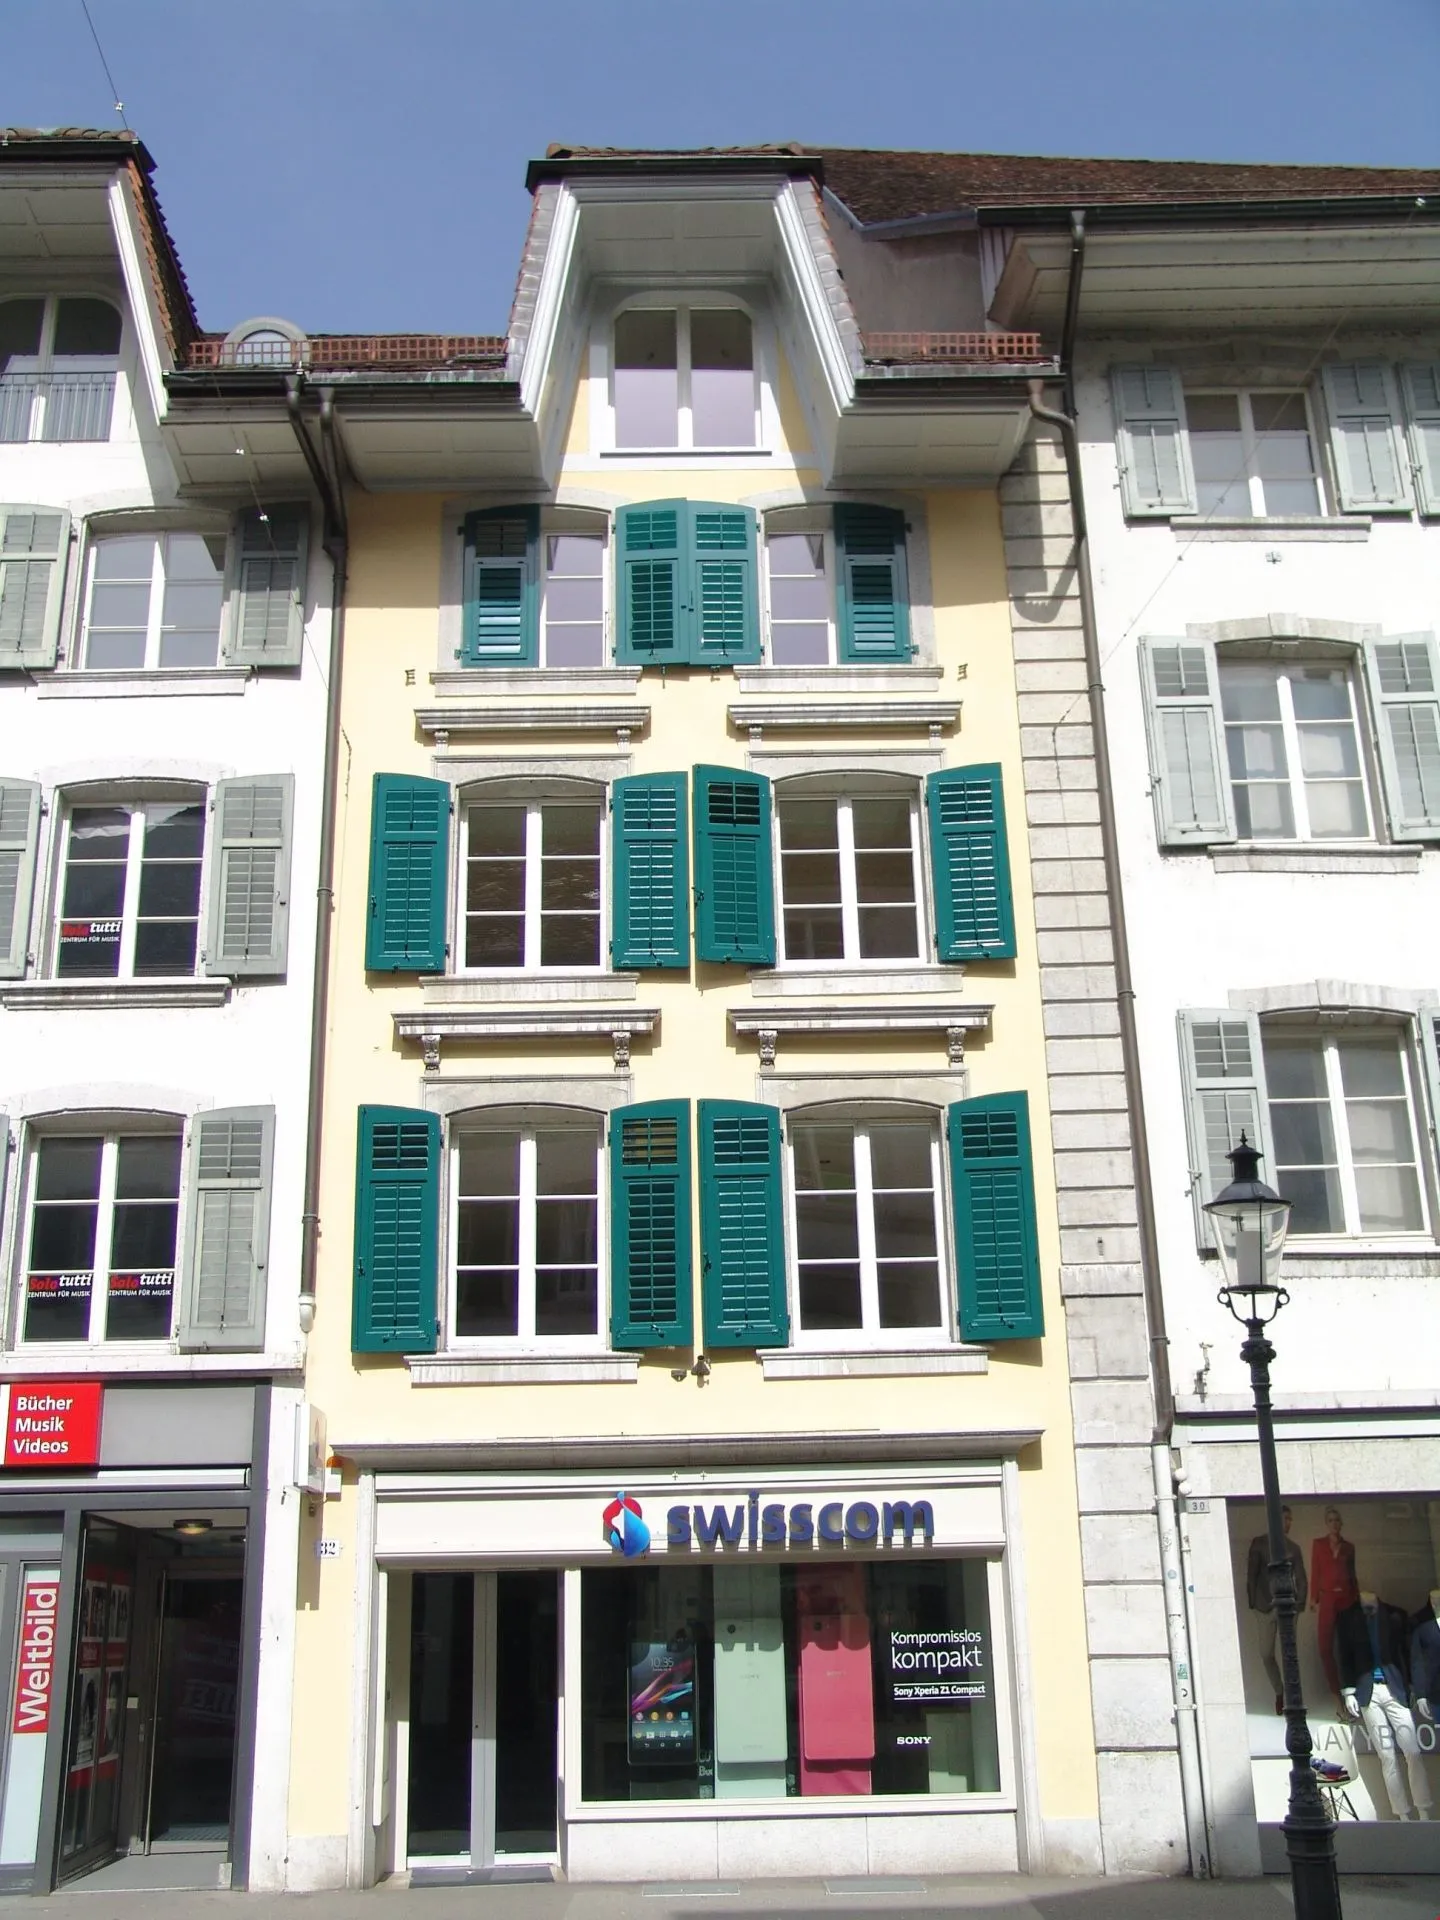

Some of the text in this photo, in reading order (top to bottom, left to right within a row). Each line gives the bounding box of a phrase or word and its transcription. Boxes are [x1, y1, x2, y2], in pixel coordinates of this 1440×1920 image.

[90, 921, 121, 932] tutti
[59, 1273, 92, 1287] tutti
[139, 1272, 173, 1286] tutti
[17, 1396, 73, 1411] Bücher
[15, 1416, 64, 1432] Musik
[13, 1439, 69, 1454] Videos
[1192, 1501, 1205, 1511] 30
[666, 1489, 935, 1543] swisscom
[320, 1542, 336, 1555] 32
[890, 1629, 982, 1648] Kompromisslos
[18, 1587, 57, 1728] Weltbild
[891, 1644, 983, 1675] kompakt
[893, 1684, 986, 1698] Sony Xperia Z1 Compact
[896, 1736, 932, 1745] SONY
[1311, 1723, 1440, 1751] NAVYBOO
